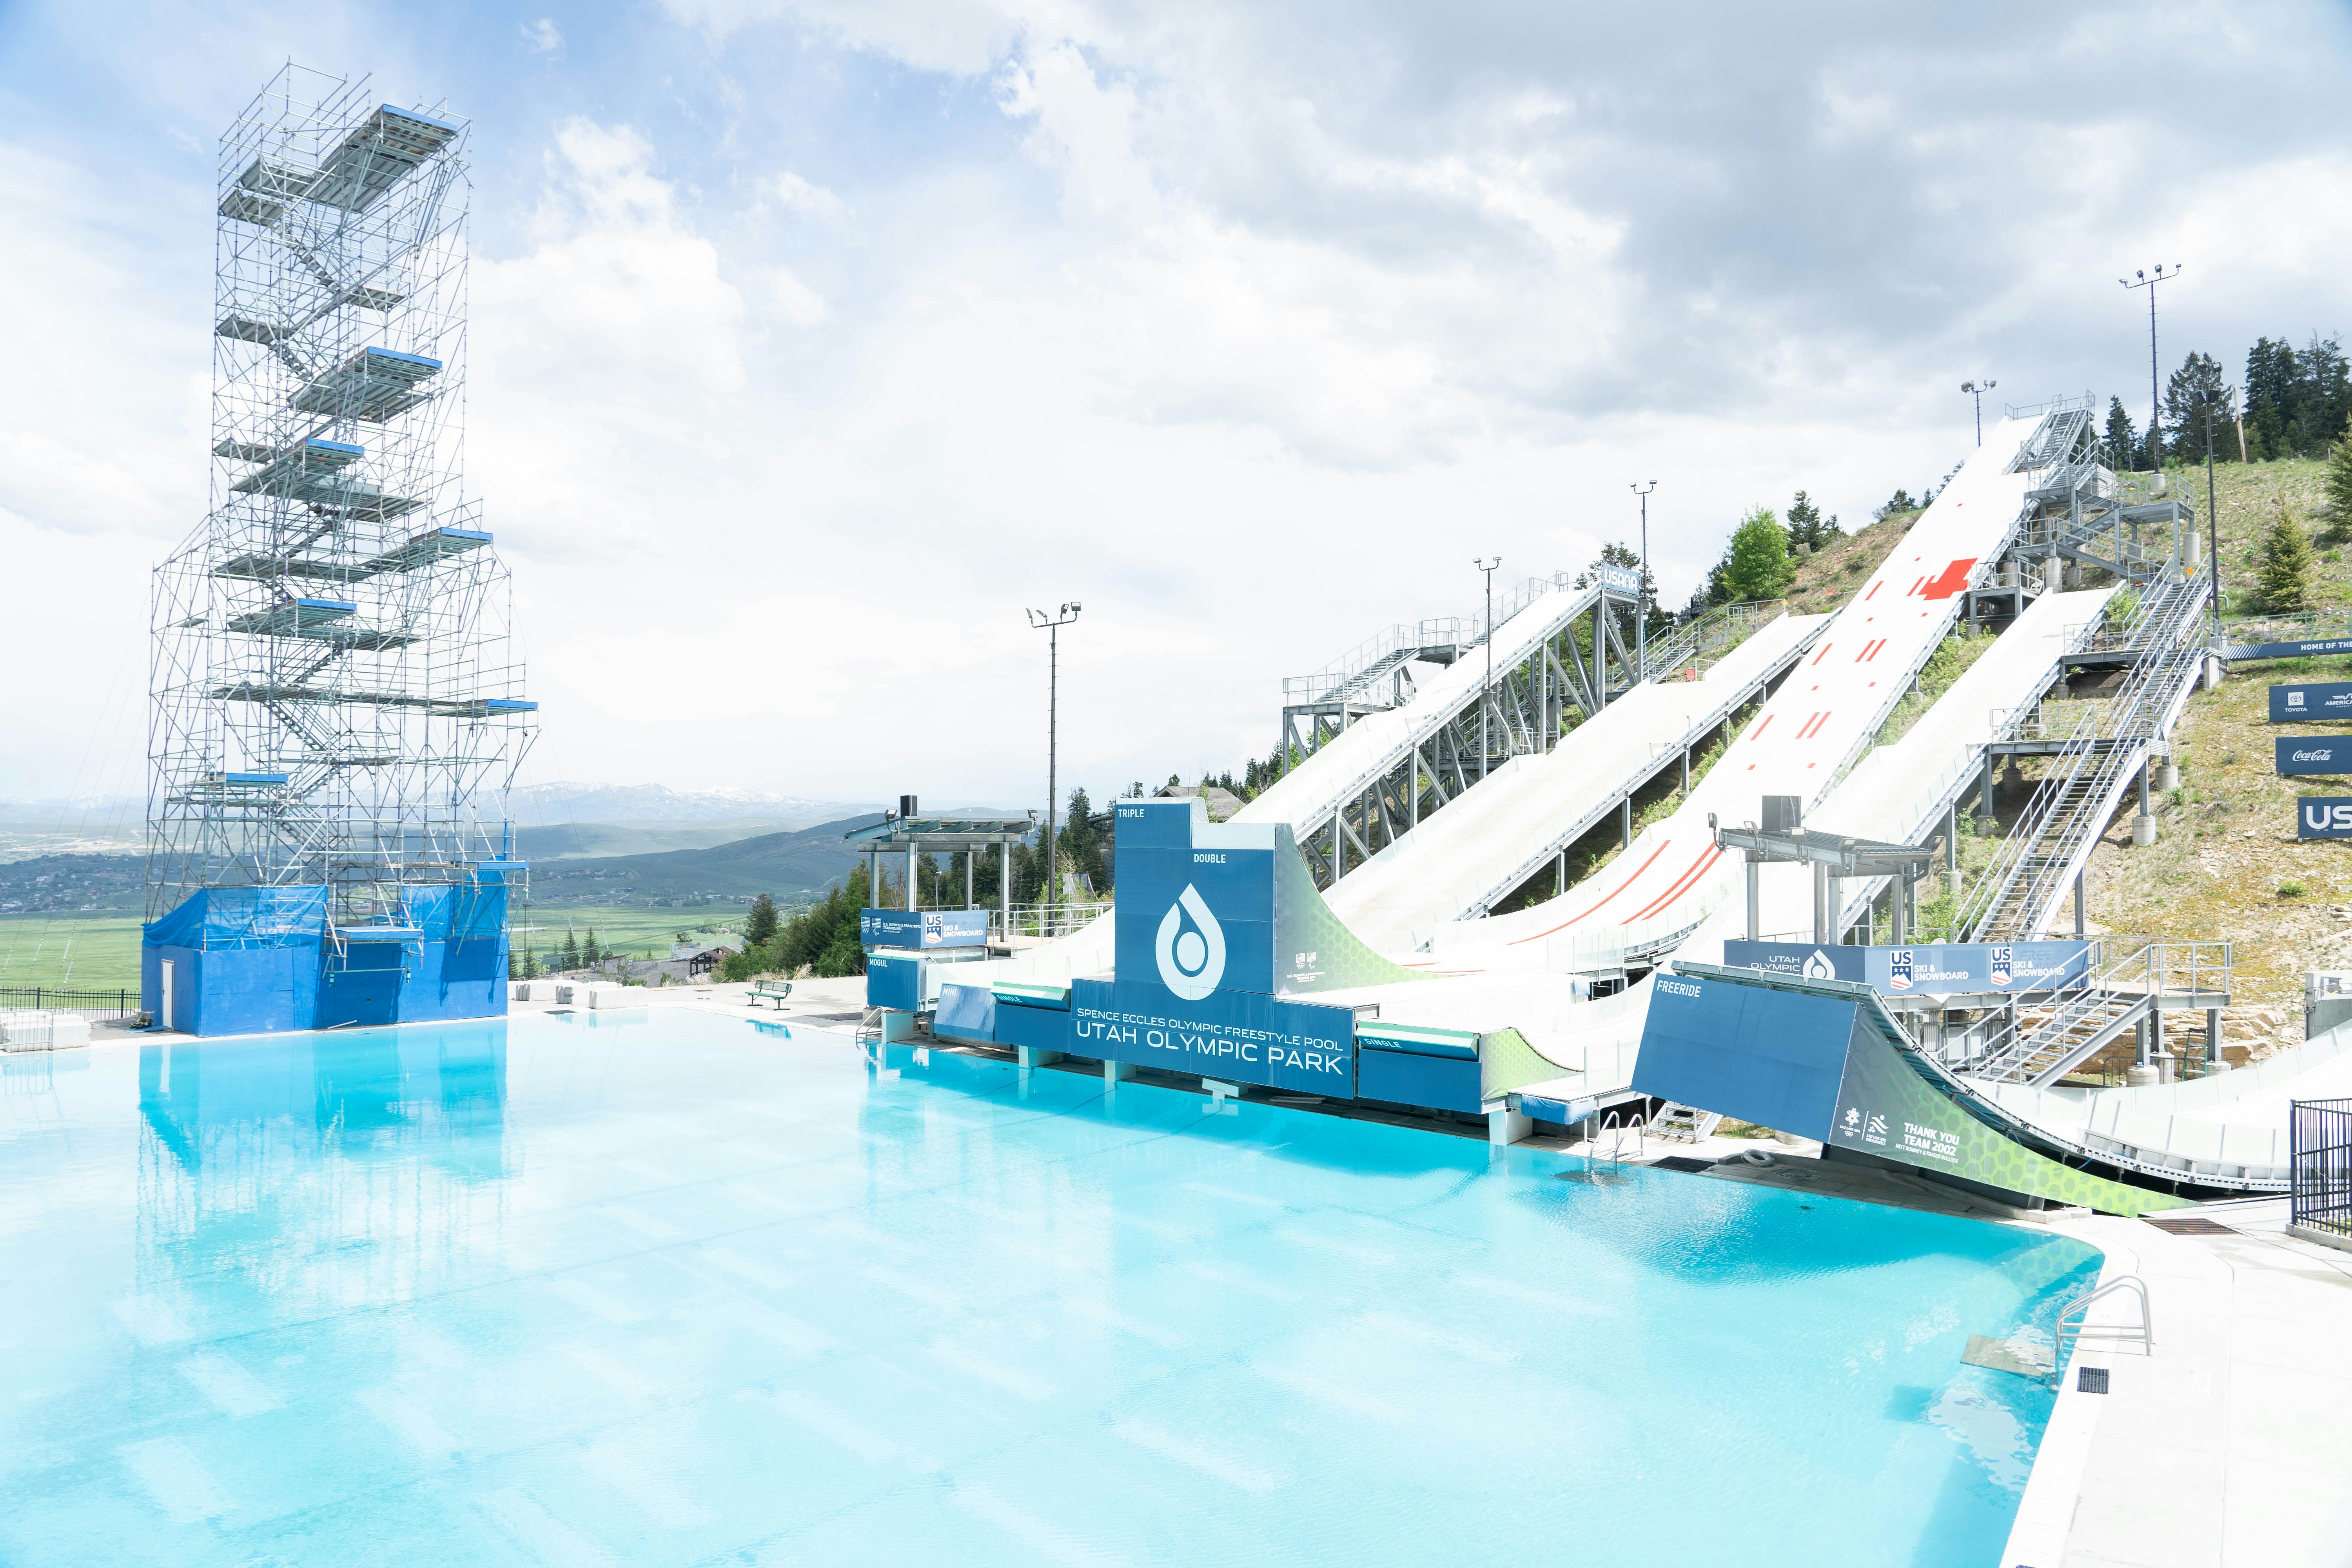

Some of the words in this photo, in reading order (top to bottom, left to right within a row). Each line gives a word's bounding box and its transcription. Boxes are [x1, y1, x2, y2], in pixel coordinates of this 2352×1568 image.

[1604, 568, 1638, 591] USANA
[1118, 809, 1144, 818] TRIPLE
[1194, 854, 1226, 863] DOUBLE
[927, 916, 941, 926] US
[1891, 952, 1911, 965] US
[1992, 948, 2011, 961] US
[869, 958, 887, 967] MOGUL
[1750, 962, 1800, 972] OLYMPIC
[2013, 961, 2026, 969] SKI
[1914, 971, 1969, 981] SNOWBOARD
[2013, 967, 2065, 977] SNOWBOARD
[943, 987, 956, 996] MINI
[1657, 980, 1702, 998] FREERIDE
[1077, 1008, 1120, 1021] SPENCE
[1123, 1014, 1165, 1027] ECCLES
[1169, 1019, 1222, 1034] OLYMPIC
[1225, 1026, 1300, 1045] FREESTYLE
[1304, 1037, 1343, 1051] POOL
[1077, 1021, 1136, 1044] UTAH
[1147, 1030, 1258, 1062] OLYMPIC
[1268, 1047, 1343, 1075] PARK
[1364, 1038, 1402, 1048] SINGLE
[1904, 1122, 1937, 1140] THANK
[1939, 1131, 1960, 1145] YOU
[1904, 1134, 1931, 1150] TEAM
[1931, 1141, 1956, 1157] 2002
[1905, 1146, 1922, 1154] ROMNEY
[1926, 1151, 1941, 1159] FRASER
[1940, 1154, 1959, 1164] BULLOCK
